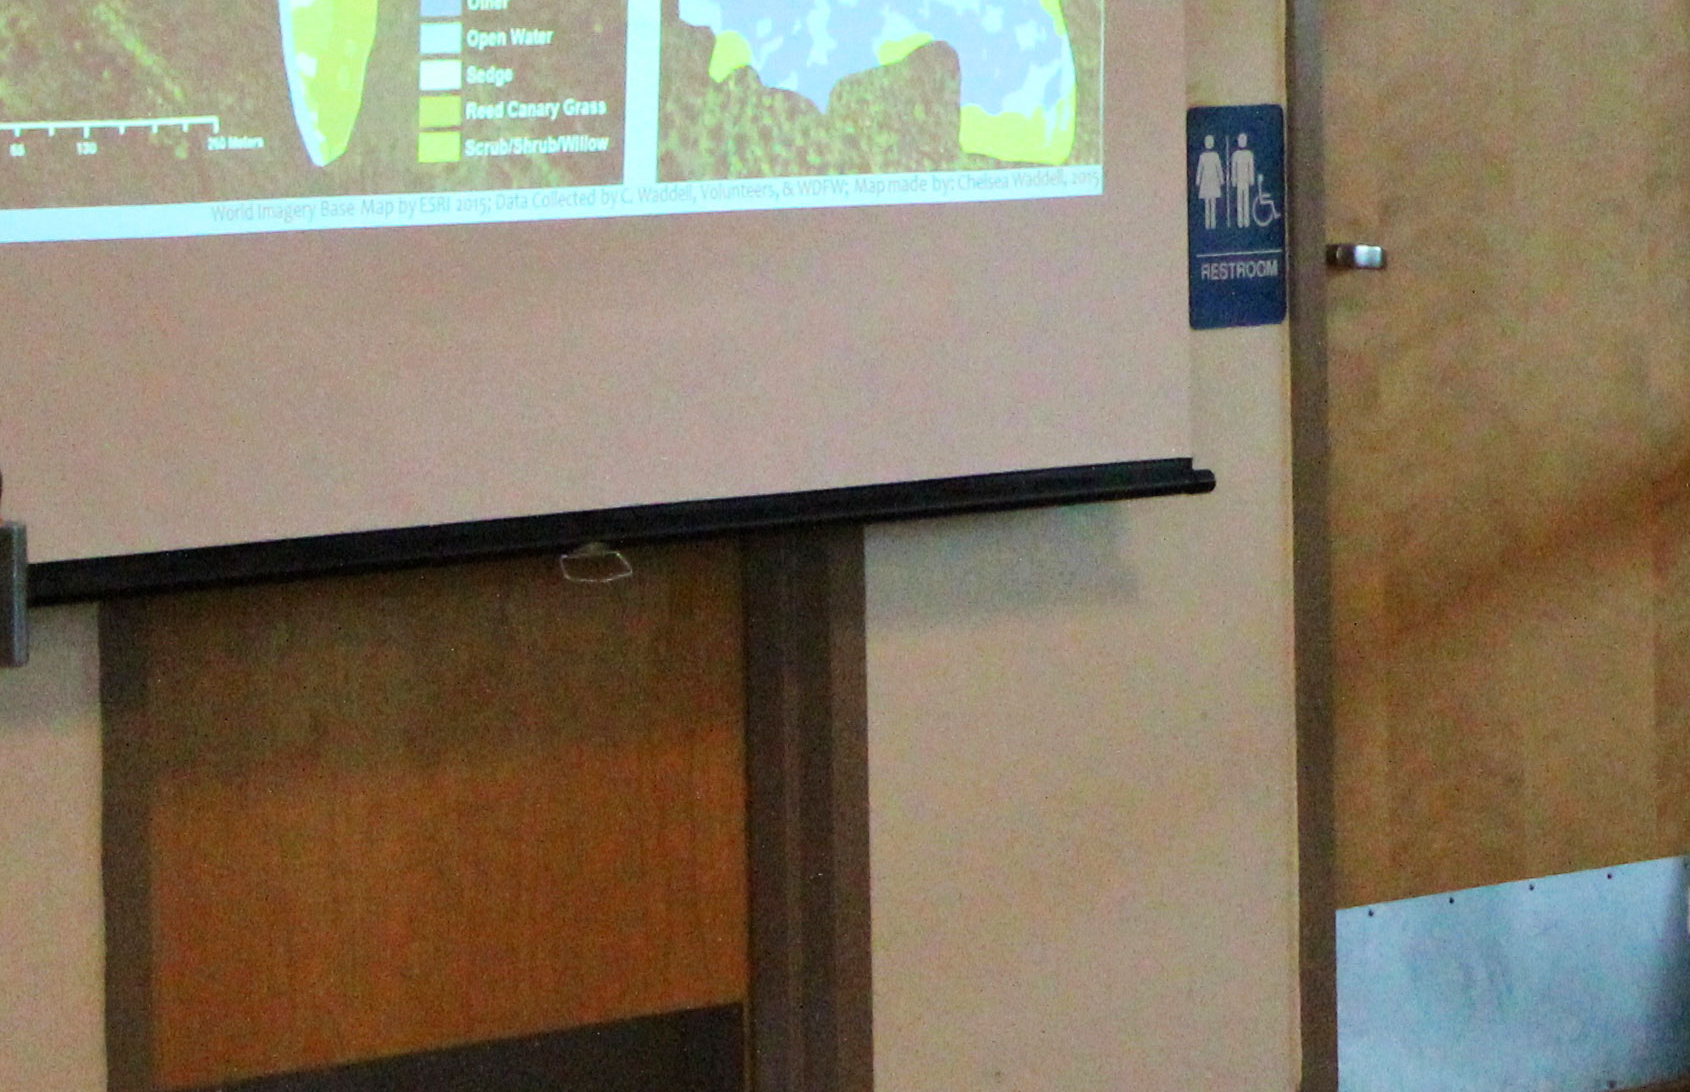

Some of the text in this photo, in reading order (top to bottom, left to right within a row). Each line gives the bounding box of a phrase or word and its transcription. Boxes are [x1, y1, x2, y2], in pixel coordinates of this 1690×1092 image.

[466, 28, 554, 50] Open Water
[466, 65, 514, 87] Sedge
[465, 98, 608, 121] Reed Canary Grass
[464, 134, 610, 157] Scrub/Shrub/Willow
[210, 205, 254, 222] World
[257, 203, 316, 223] Imagery
[320, 200, 355, 218] Base
[360, 199, 394, 219] Map
[398, 197, 417, 217] by
[419, 196, 450, 214] ESRI
[495, 192, 528, 210] Data
[532, 189, 597, 208] Collected
[601, 188, 618, 208] by
[637, 185, 697, 204] Waddell,
[702, 182, 780, 201] Volunteers,
[782, 181, 795, 197] &
[799, 179, 850, 198] WDFW;
[854, 178, 886, 197] Map
[887, 176, 928, 193] made
[932, 174, 955, 196] by:
[957, 172, 1010, 191] Chelsea
[1012, 168, 1068, 188] Waddell,
[1201, 259, 1279, 281] RESTROOM
